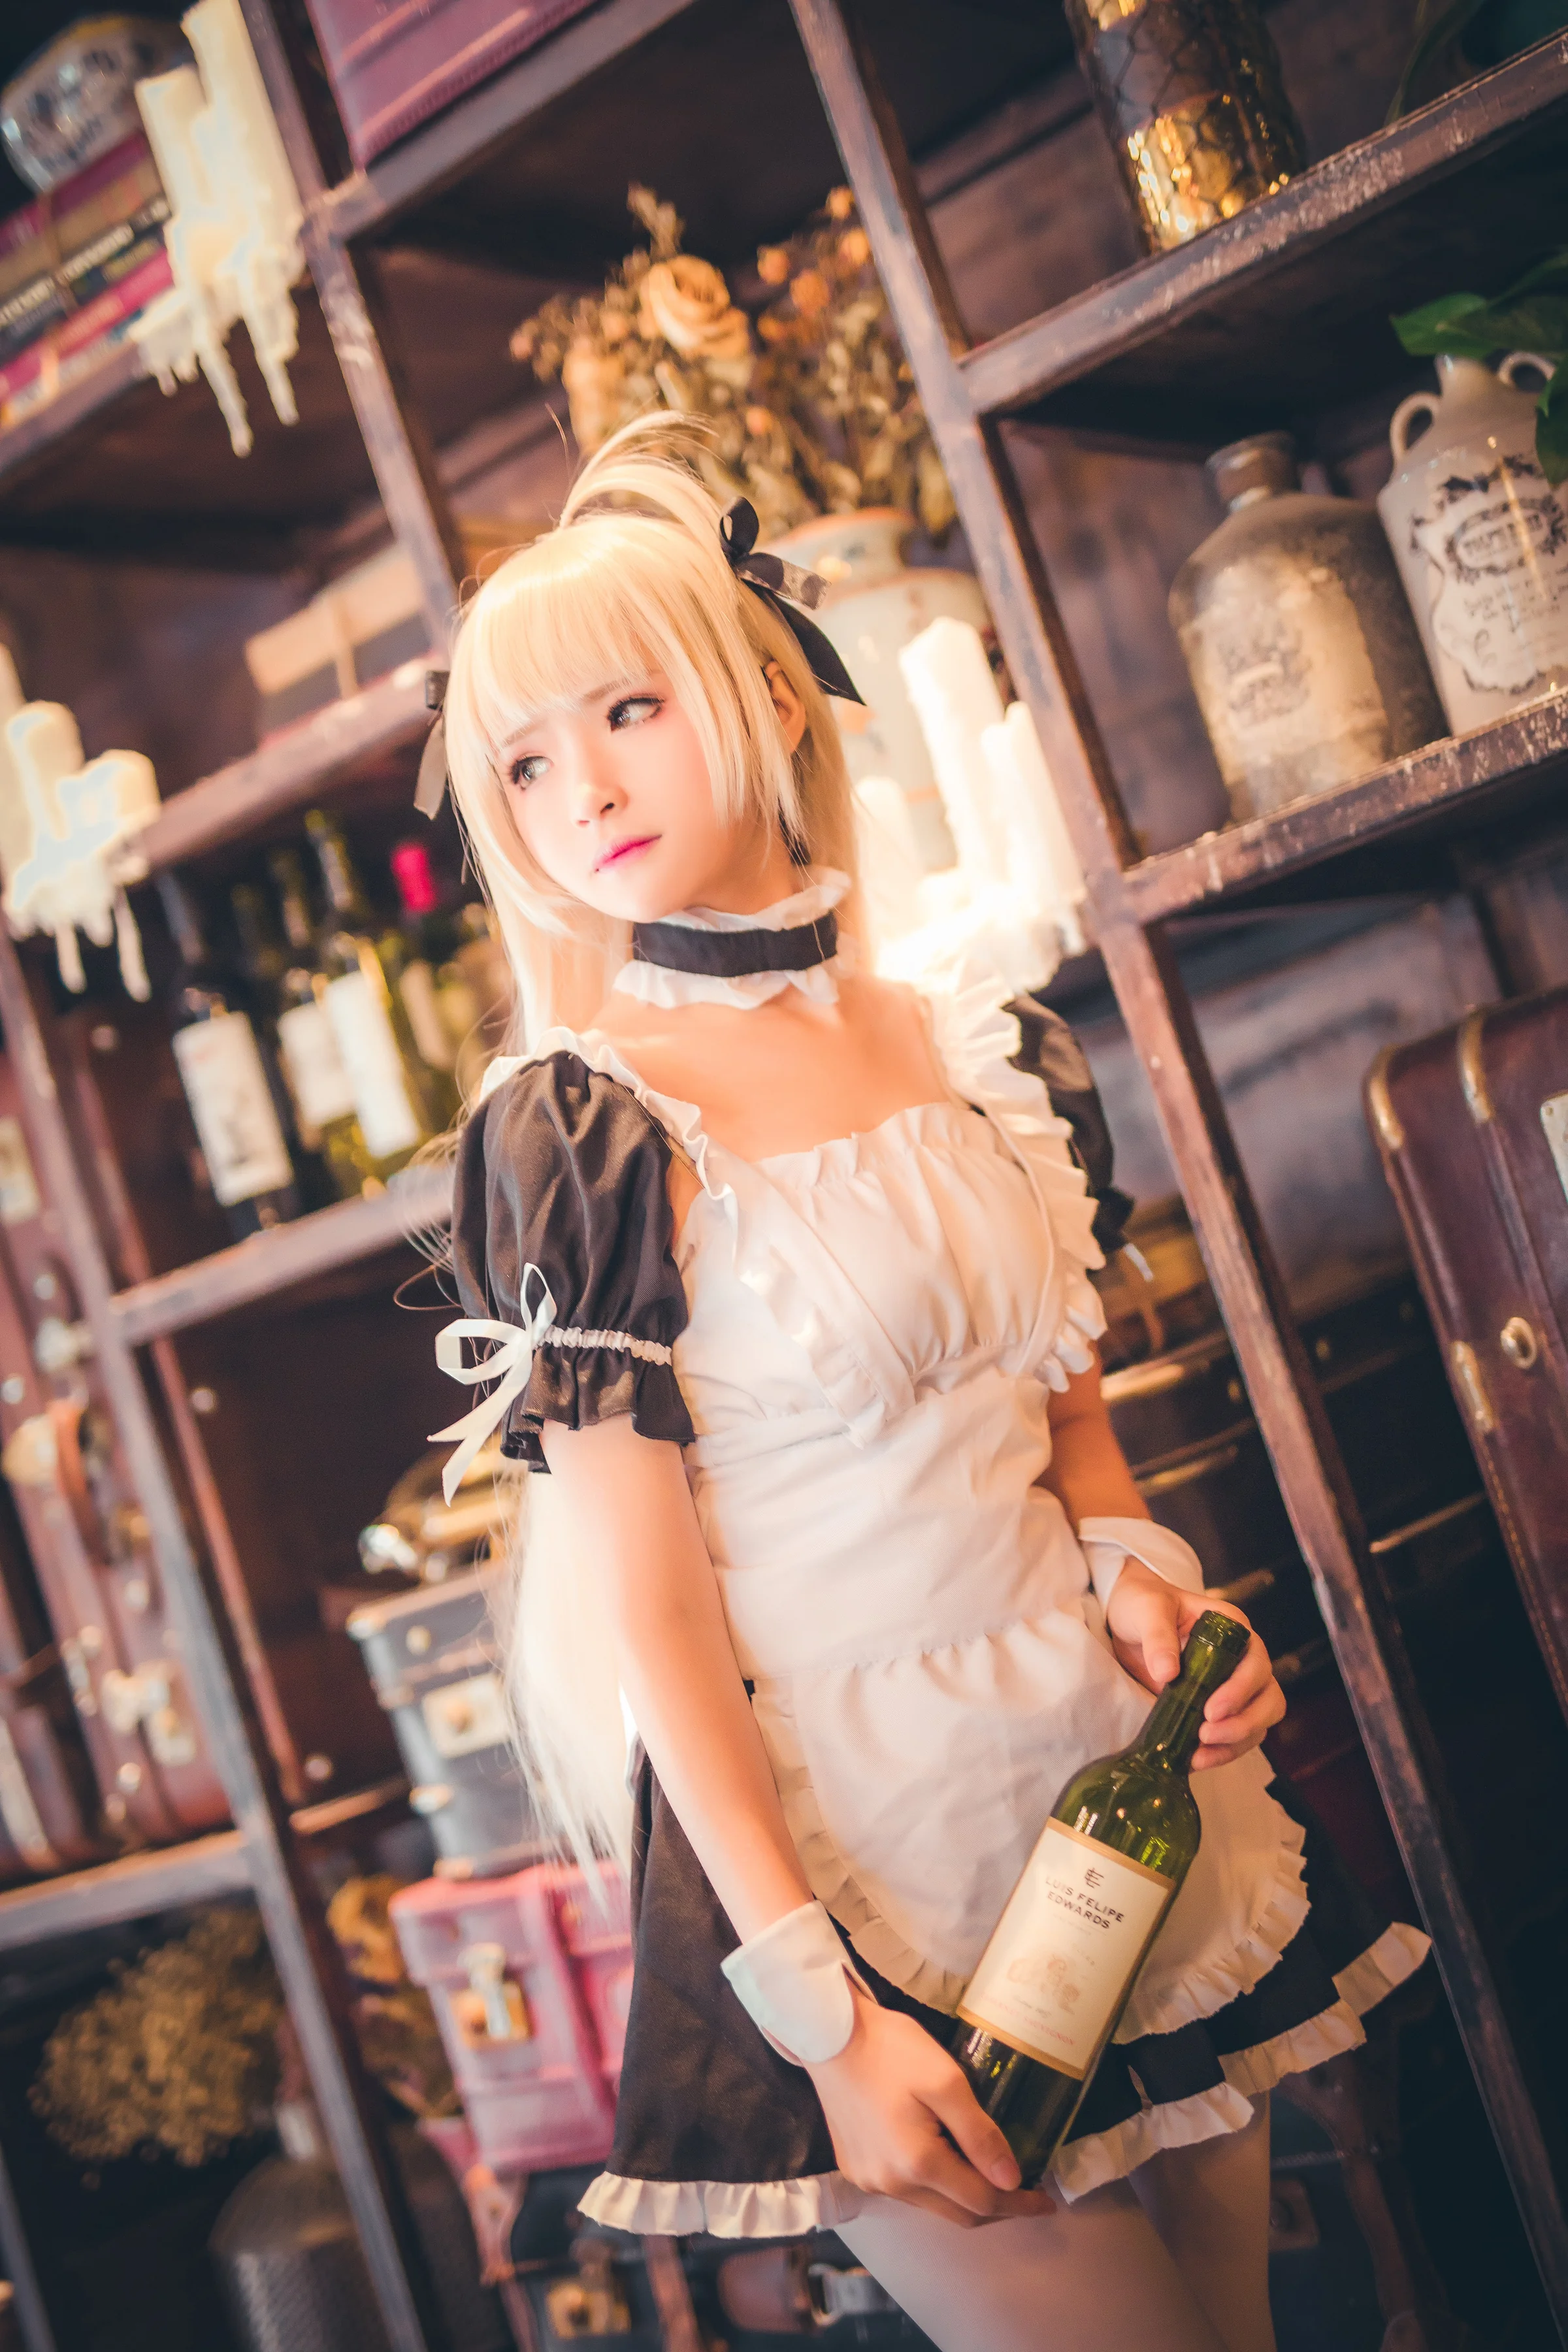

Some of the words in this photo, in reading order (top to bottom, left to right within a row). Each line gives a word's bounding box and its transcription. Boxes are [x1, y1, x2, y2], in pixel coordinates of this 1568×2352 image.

[1045, 1875, 1075, 1897] LUIS
[1077, 1892, 1125, 1923] FELIPE
[1047, 1890, 1111, 1929] EDWARDS
